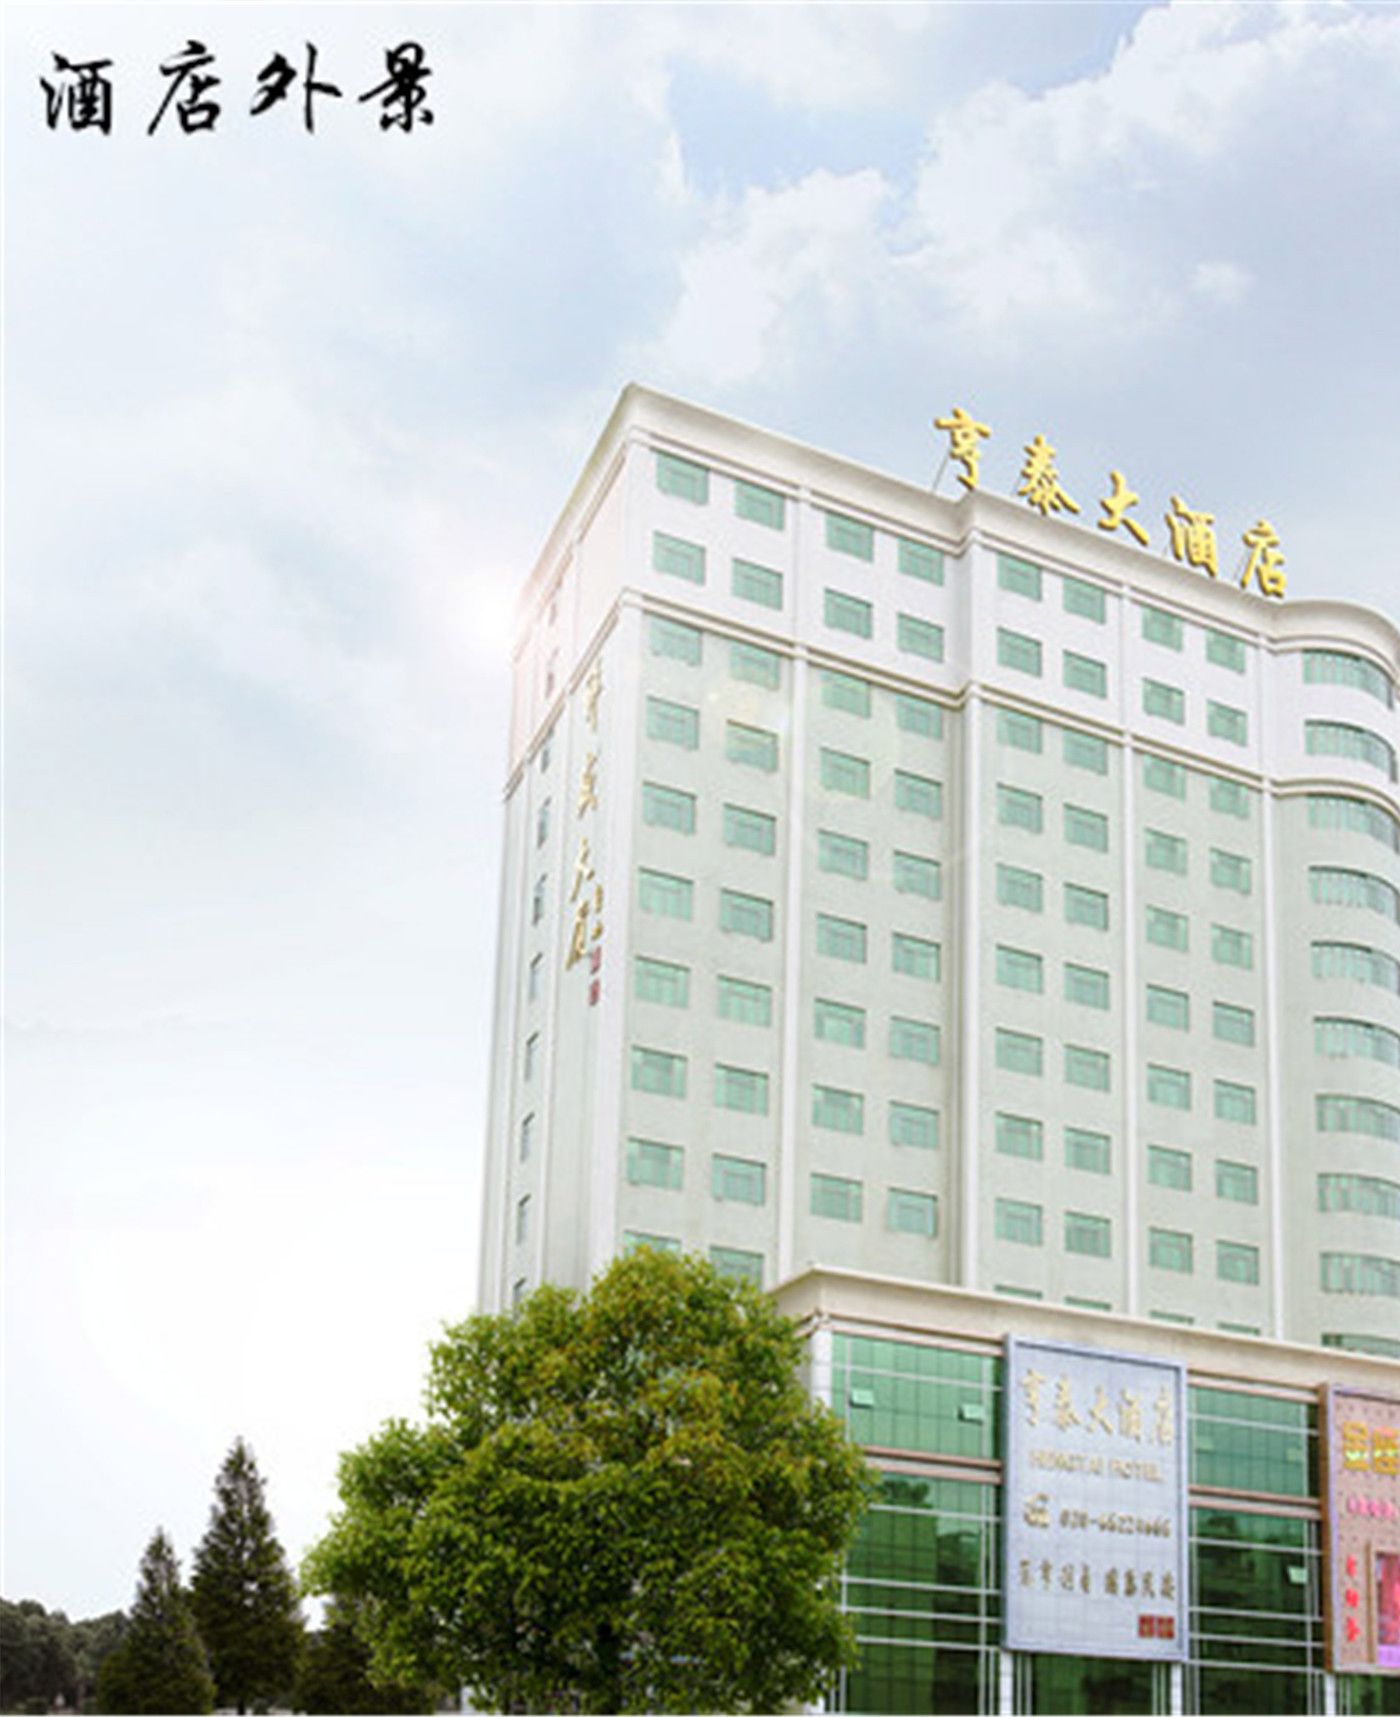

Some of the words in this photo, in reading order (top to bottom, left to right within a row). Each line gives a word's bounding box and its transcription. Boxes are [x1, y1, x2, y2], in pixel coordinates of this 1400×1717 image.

[933, 407, 1287, 599] 亨泰大酒店
[1019, 1368, 1175, 1447] 亨泰大酒店
